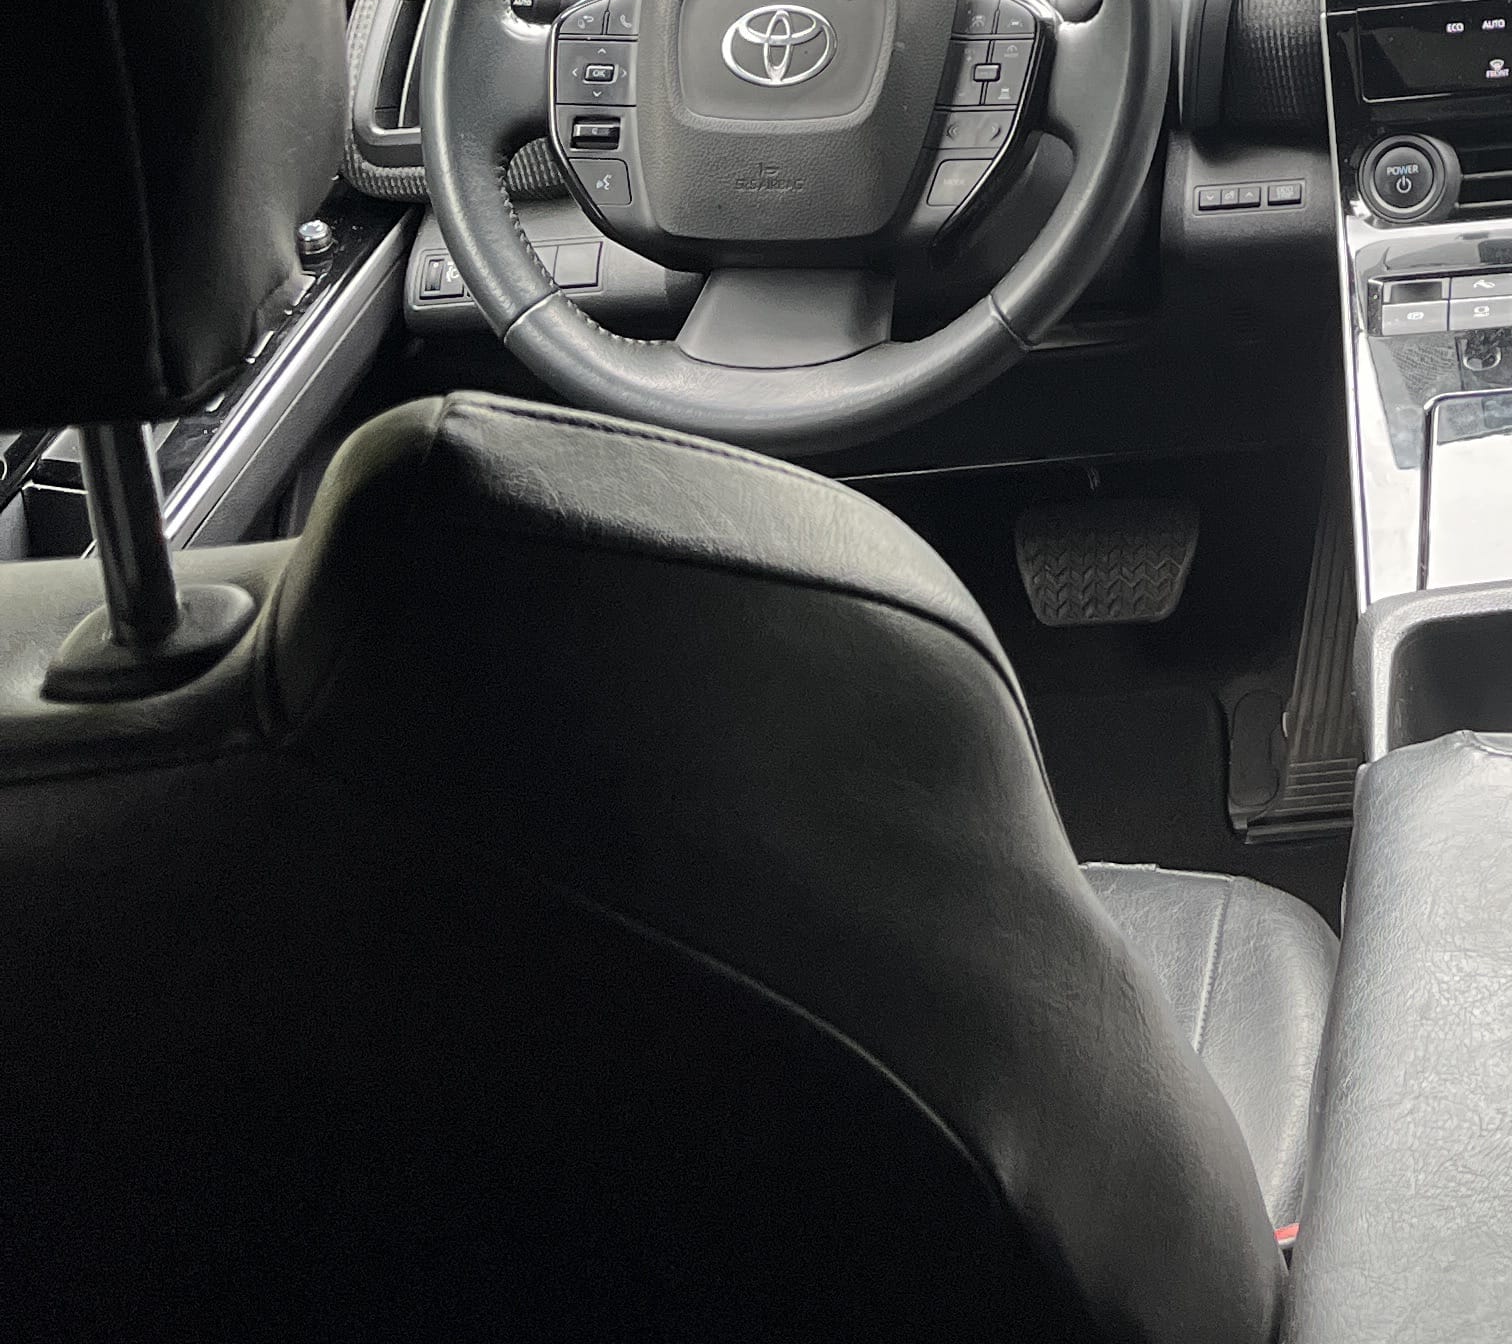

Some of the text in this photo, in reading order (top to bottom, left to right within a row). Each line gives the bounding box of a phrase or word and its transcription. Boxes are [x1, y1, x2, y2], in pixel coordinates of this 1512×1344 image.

[1446, 22, 1464, 33] ECO
[1481, 18, 1506, 30] AUTO
[592, 69, 607, 78] OK
[1386, 164, 1419, 176] POWER
